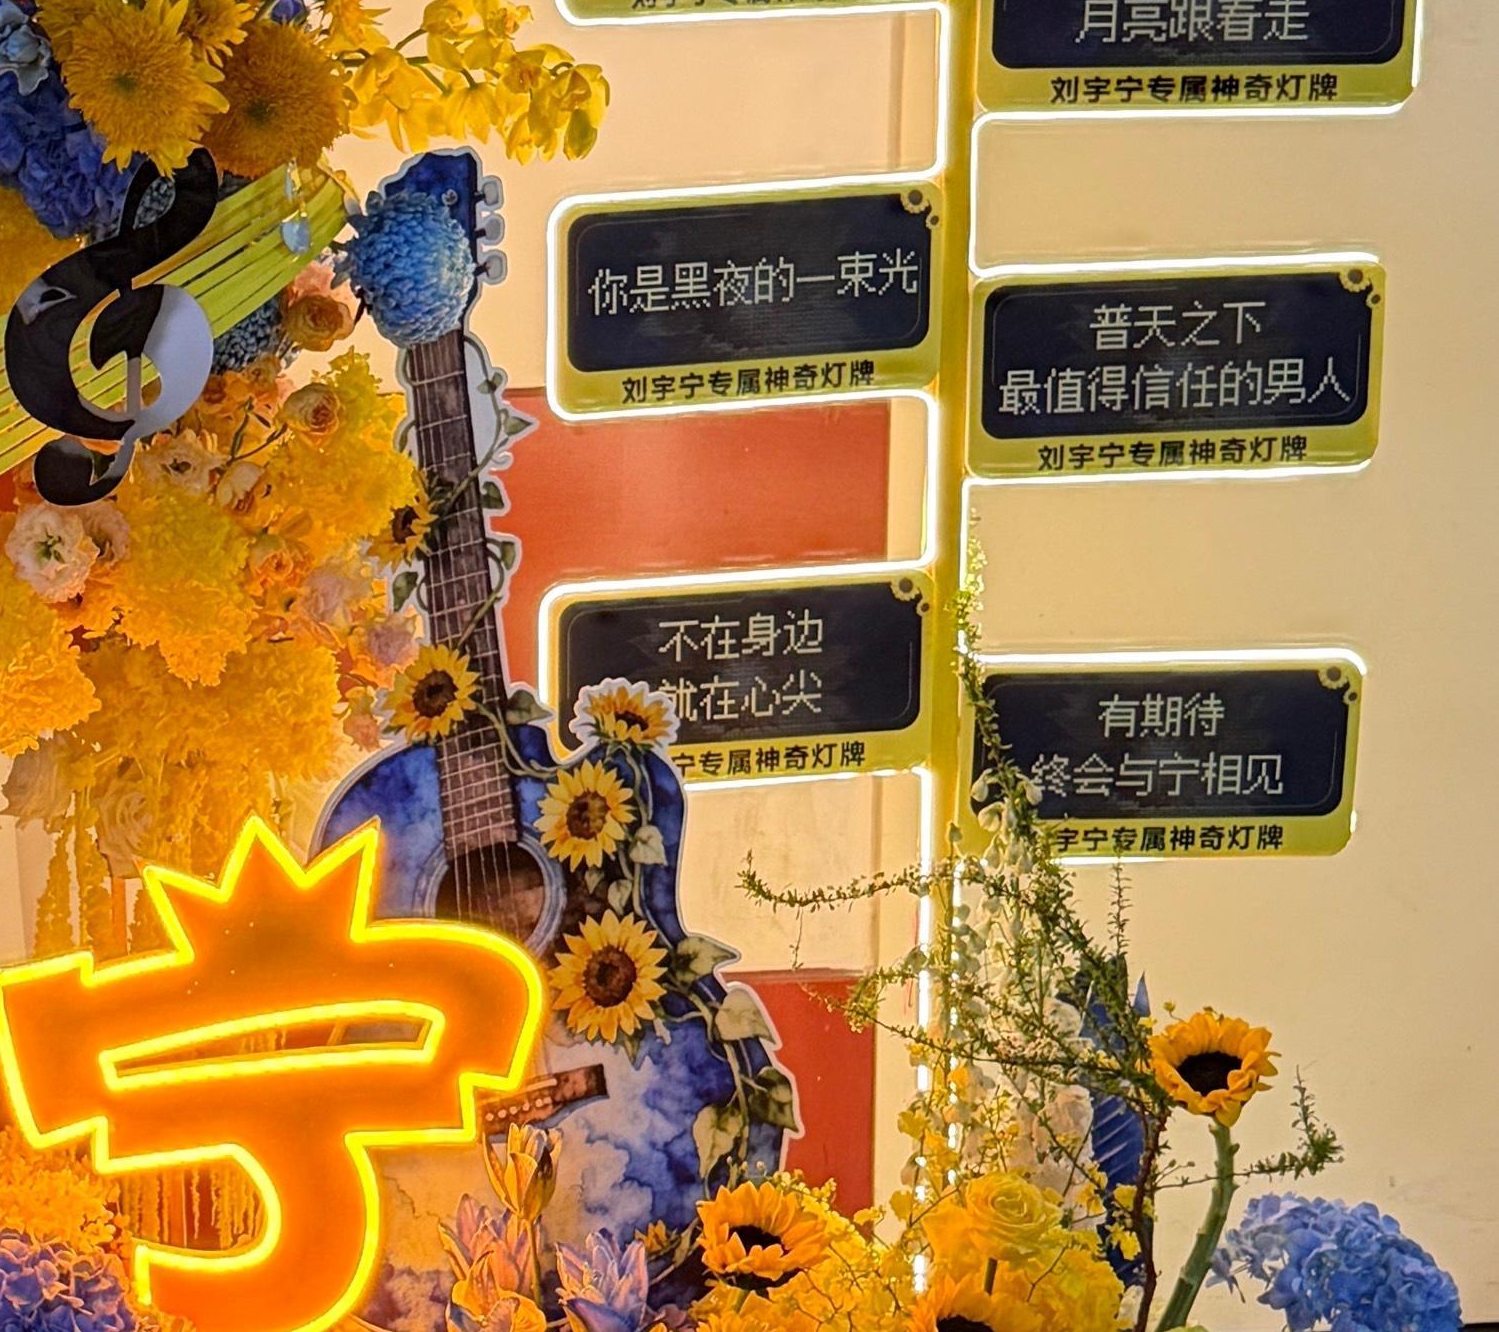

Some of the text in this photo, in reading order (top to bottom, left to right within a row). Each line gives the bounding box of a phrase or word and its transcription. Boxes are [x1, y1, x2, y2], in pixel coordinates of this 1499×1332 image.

[1050, 73, 1339, 105] 刘宇宁专属神奇灯牌
[587, 247, 920, 316] 你是黑夜的一束光
[1089, 300, 1266, 351] 普天之下
[621, 359, 876, 405] 刘宇宁专属神奇灯牌
[998, 355, 1351, 416] 最值得信任的男人
[1037, 435, 1308, 471] 刘宇宁专属神奇灯牌
[658, 608, 823, 663] 不在身边
[658, 668, 822, 722] 就在心尖
[1097, 691, 1226, 738] 有期待
[1031, 751, 1284, 798] 终会与宁相见
